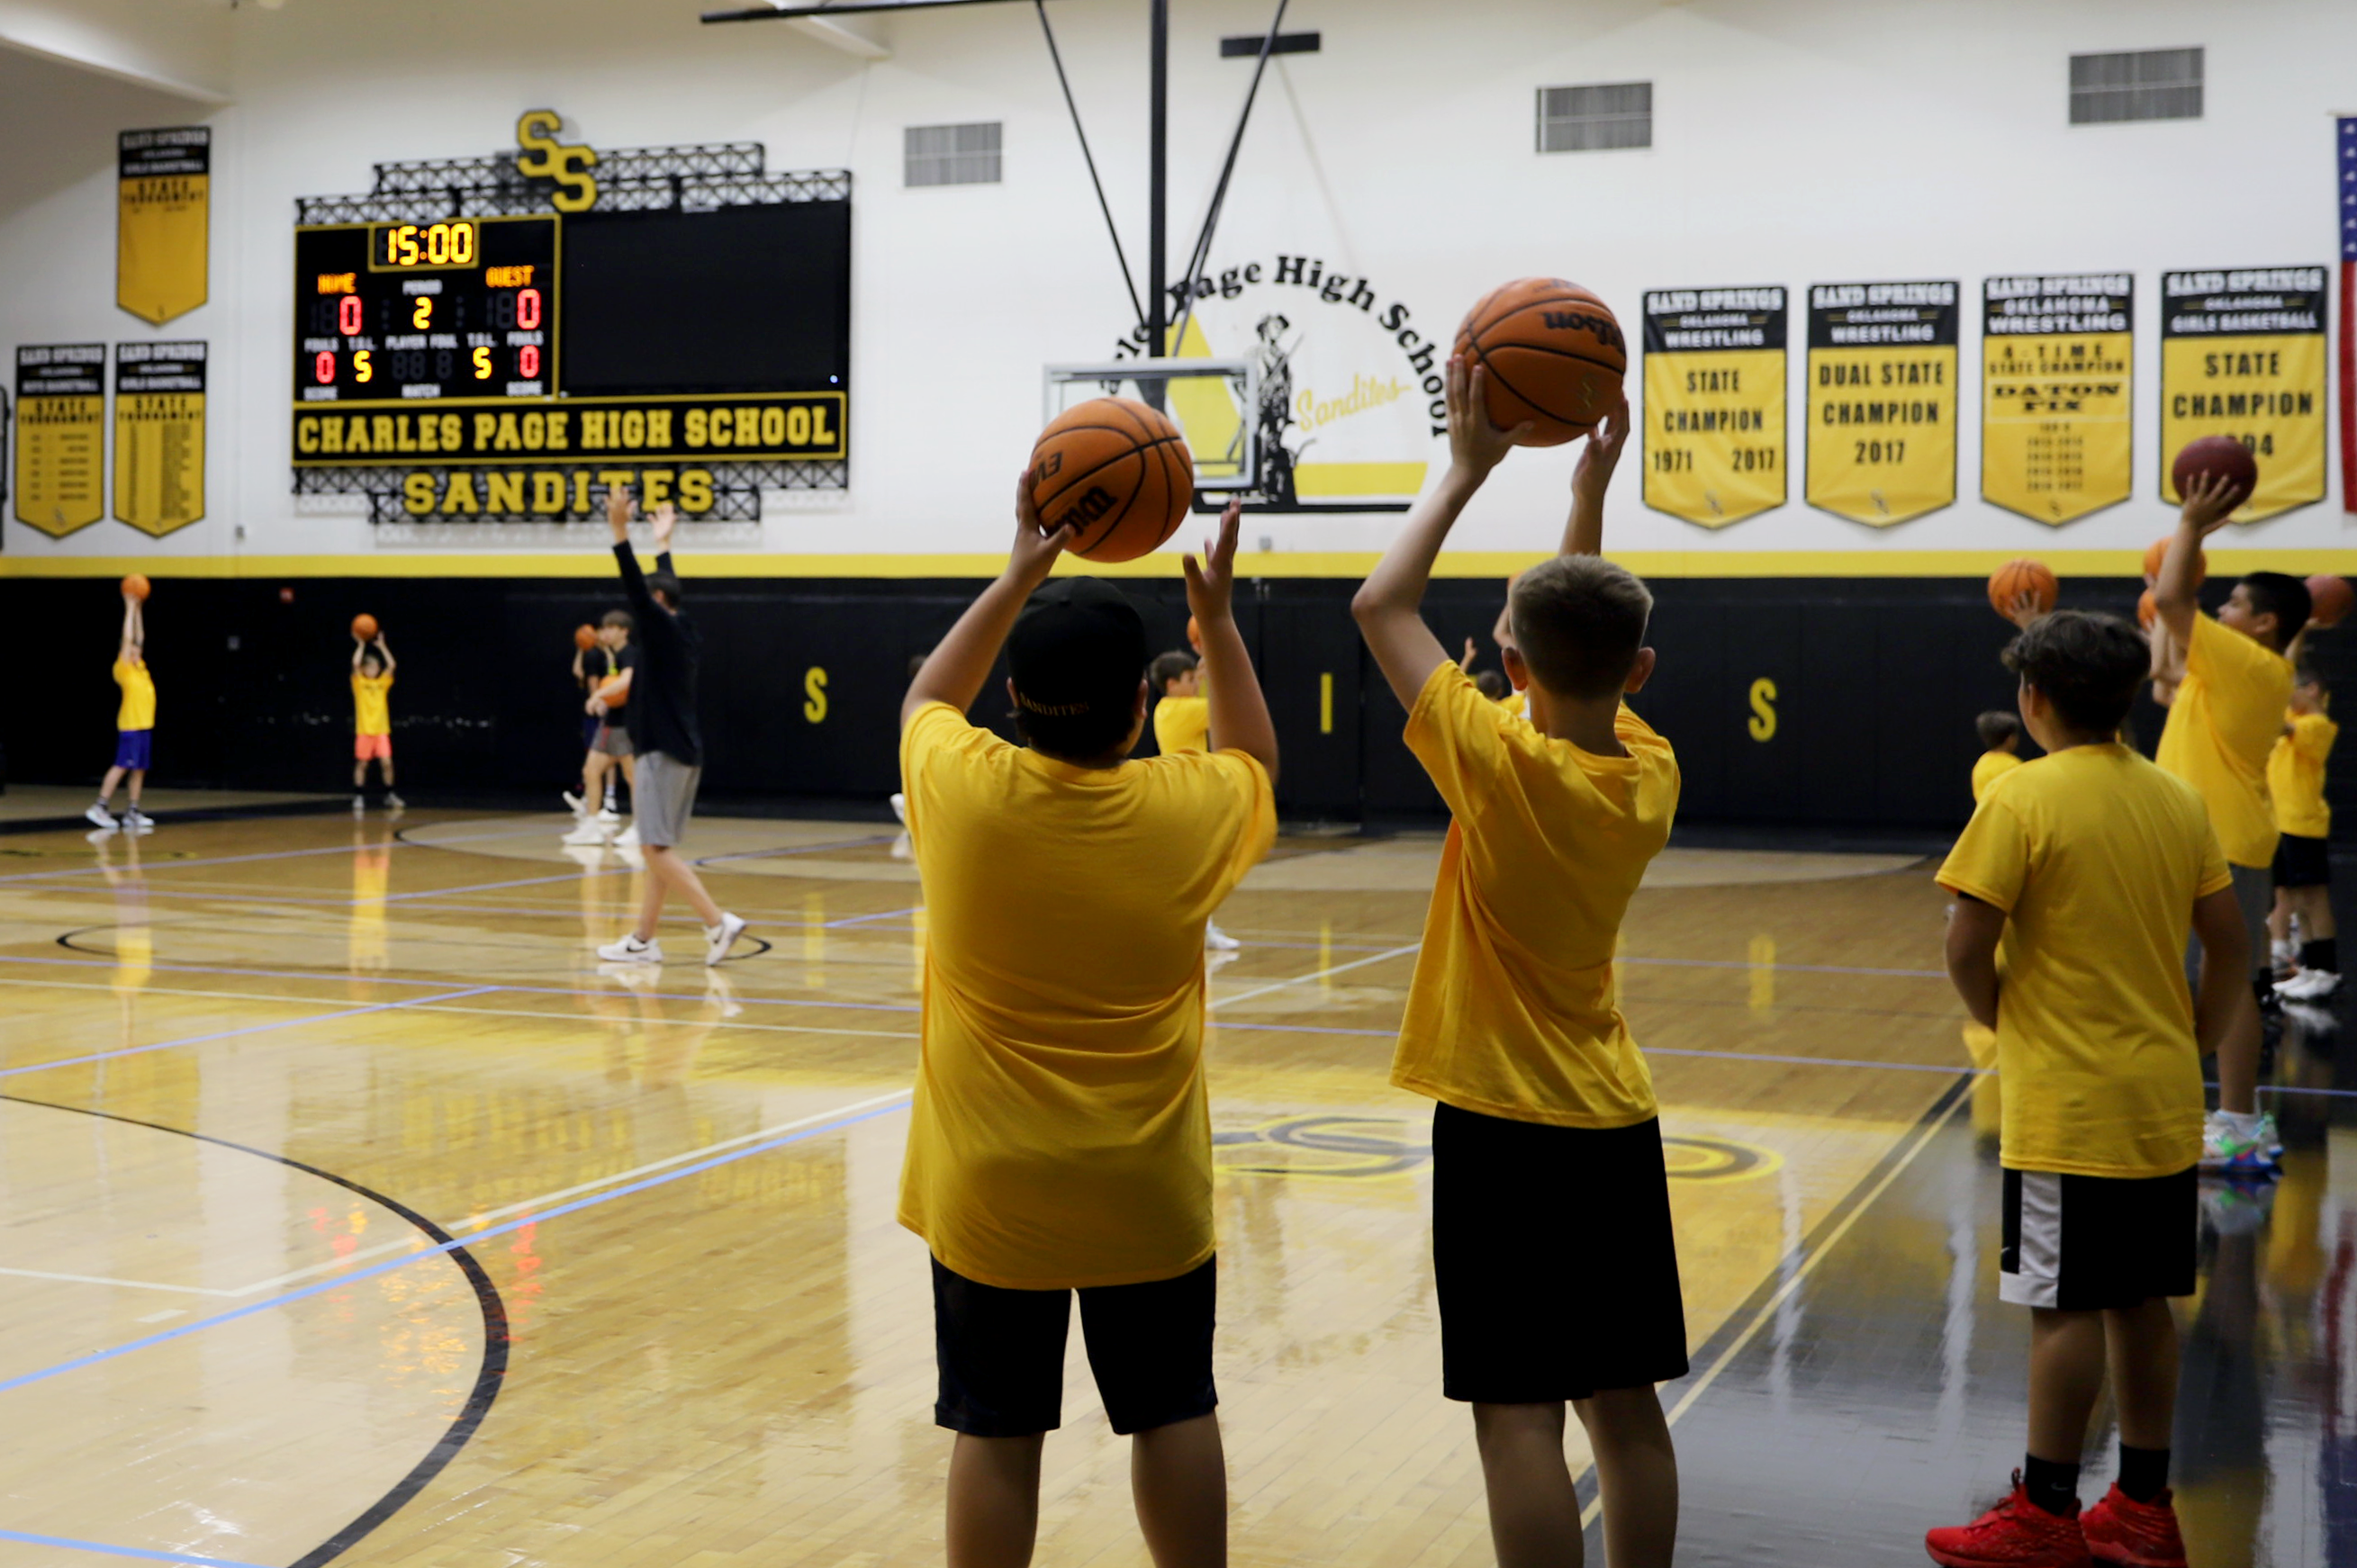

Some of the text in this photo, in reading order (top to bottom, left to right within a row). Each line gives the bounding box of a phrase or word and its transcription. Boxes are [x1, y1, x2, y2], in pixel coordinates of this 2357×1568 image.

[388, 222, 474, 266] 15:00
[485, 266, 535, 287] GUEST
[1274, 256, 1375, 311] High
[1987, 275, 2129, 300] SAND SPRINGS
[2167, 268, 2324, 297] SAND SPRINGS
[517, 288, 540, 329] 0
[1648, 288, 1783, 314] SAND SPRINGS
[1813, 284, 1955, 309] SAND SPRINGS
[2003, 296, 2109, 315] OKLAHOMA
[339, 295, 362, 336] 0
[413, 296, 432, 329] 2
[1989, 313, 2127, 333] WRESTLING
[2219, 311, 2317, 331] BASKETBALL
[1666, 329, 1765, 347] WRESTLING
[1831, 325, 1935, 343] WRESTLING
[315, 351, 336, 383] 0
[353, 350, 373, 383] 5
[473, 347, 492, 379] 5
[519, 345, 539, 378] 0
[1819, 363, 1943, 386] DUAL STATE
[2204, 352, 2280, 377] STATE
[1687, 370, 1740, 393] STATE
[1296, 372, 1412, 432] Sandites
[1823, 402, 1938, 425] CHAMPION
[2173, 392, 2313, 419] CHAMPION
[298, 406, 836, 453] CHARLES PAGE HIGH SCHOOL
[1664, 410, 1763, 432] CHAMPION
[1653, 449, 1775, 472] 1971 2017
[1856, 441, 1905, 464] 2017
[403, 469, 714, 514] SANDITES
[804, 665, 827, 724] S
[1747, 677, 1777, 743] S
